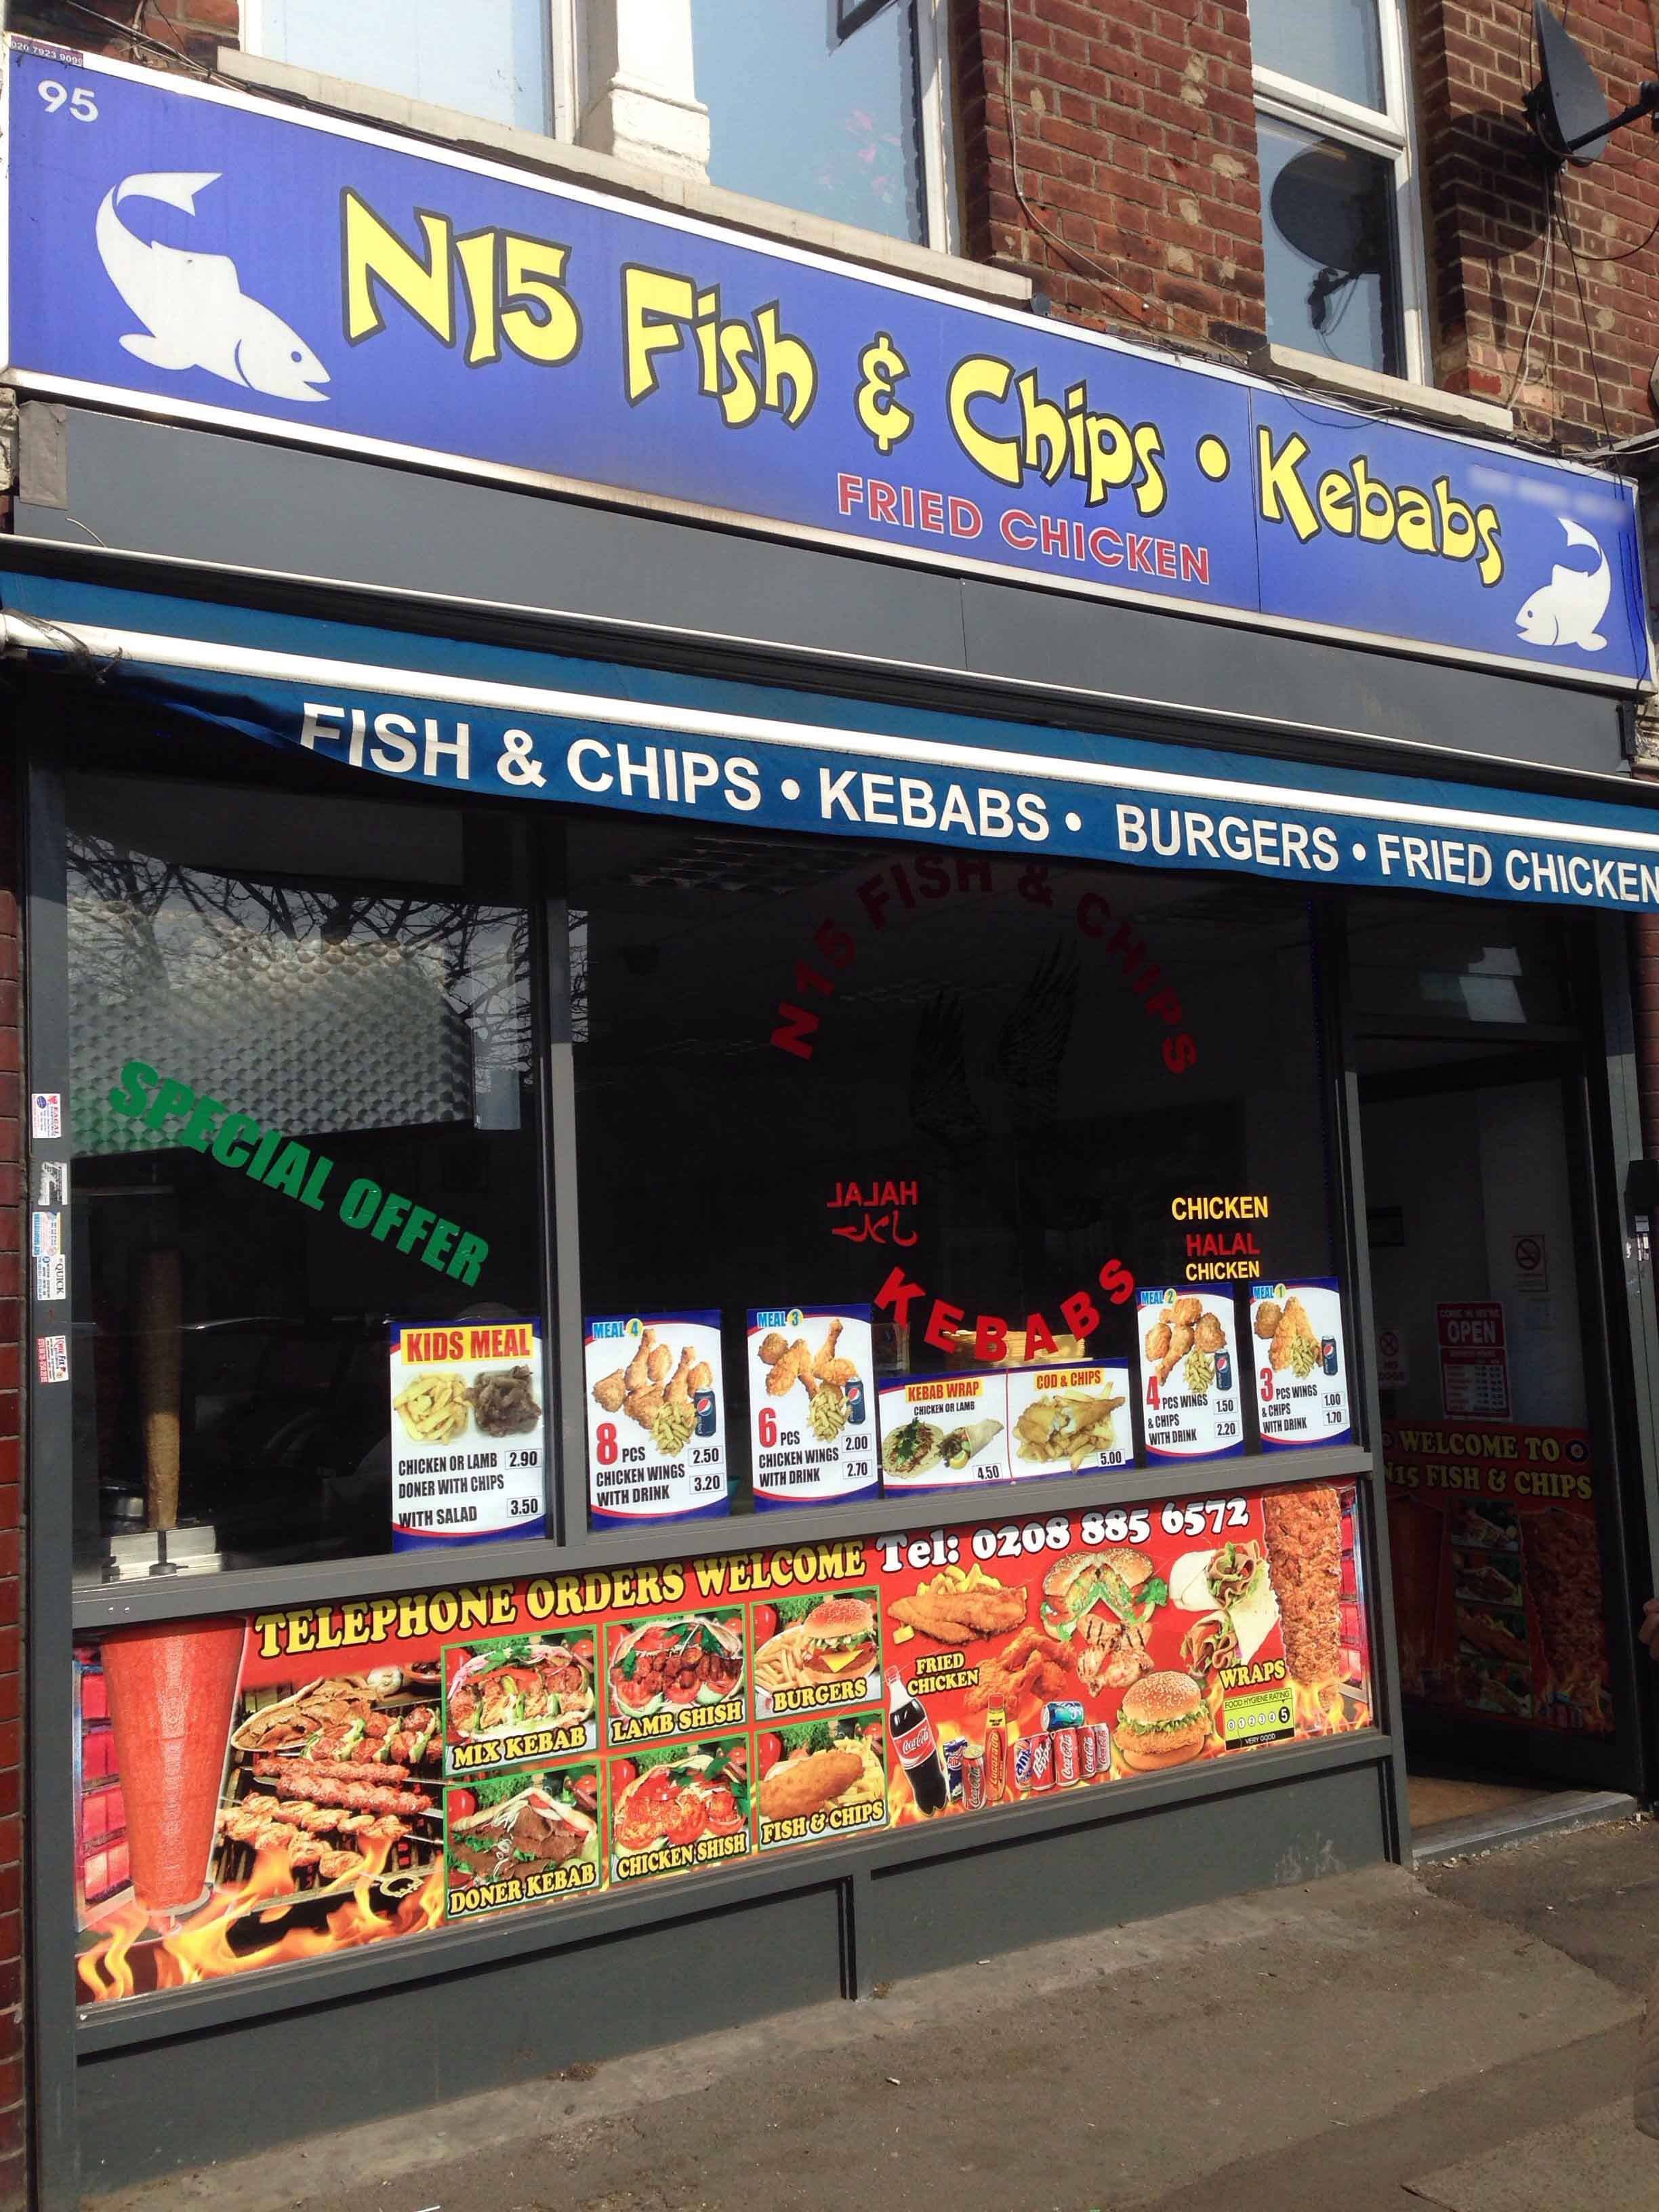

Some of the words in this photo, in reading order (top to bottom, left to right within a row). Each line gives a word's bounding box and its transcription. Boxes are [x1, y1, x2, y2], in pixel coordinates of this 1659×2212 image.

[33, 46, 56, 59] 7923
[38, 79, 98, 122] 95
[342, 188, 581, 367] N15
[621, 263, 817, 429] Fish
[855, 331, 914, 455] &
[948, 354, 1166, 517] Chips
[1257, 426, 1504, 586] Kebabs
[837, 472, 982, 539] FRIED
[1000, 510, 1210, 585] CHICKEN
[301, 702, 469, 779] FISH
[497, 729, 546, 788] &
[567, 739, 761, 811] CHIPS
[819, 768, 1049, 841] KEBABS
[1115, 804, 1338, 872] BURGERS
[1377, 834, 1492, 886] FRIED
[1506, 849, 1659, 903] CHICKEN
[769, 918, 856, 1063] N15
[857, 855, 993, 930] FISH
[1017, 864, 1052, 907] &
[1078, 893, 1197, 1073] CHIPS
[108, 1062, 335, 1211] SPECIAL
[339, 1178, 489, 1287] OFFER
[1172, 1197, 1268, 1220] CHICKEN
[1187, 1233, 1261, 1256] HALAL
[55, 1263, 64, 1294] QUICK
[1186, 1261, 1260, 1280] CHICKEN
[1141, 1291, 1164, 1305] MEAL
[1167, 1290, 1174, 1304] 2
[1252, 1286, 1274, 1300] MEAL
[1278, 1285, 1284, 1298] 1
[756, 1311, 786, 1328] MEAL
[792, 1311, 799, 1326] 3
[874, 1258, 1135, 1361] KEBABS
[592, 1322, 625, 1338] MEAL
[630, 1322, 638, 1336] 4
[1447, 1321, 1496, 1345] OPEN
[407, 1330, 464, 1361] KIDS
[470, 1328, 530, 1357] MEAL
[1036, 1374, 1057, 1389] COD
[1061, 1374, 1067, 1387] &
[1071, 1370, 1101, 1386] CHIPS
[1260, 1368, 1273, 1401] 3
[1276, 1387, 1291, 1400] PCS
[1292, 1385, 1317, 1398] WINGS
[908, 1384, 944, 1401] KEBAB
[946, 1381, 979, 1397] WRAP
[1147, 1376, 1160, 1410] 4
[1163, 1396, 1179, 1410] PCS
[1180, 1394, 1208, 1408] WINGS
[1324, 1394, 1341, 1406] 1.00
[914, 1404, 944, 1416] CHICKEN
[945, 1404, 955, 1413] OR
[956, 1401, 975, 1412] LAMB
[1216, 1399, 1233, 1412] 1.50
[1262, 1407, 1267, 1418] &
[1268, 1403, 1291, 1416] CHIPS
[758, 1408, 777, 1448] 6
[780, 1431, 800, 1446] PCS
[1147, 1418, 1153, 1429] &
[1155, 1414, 1180, 1428] CHIPS
[1263, 1419, 1283, 1433] WITH
[1284, 1417, 1307, 1431] DRINK
[1326, 1411, 1342, 1424] 1.70
[1149, 1431, 1171, 1446] WITH
[1172, 1429, 1197, 1443] DRINK
[1217, 1423, 1235, 1436] 2.20
[596, 1423, 618, 1465] 8
[622, 1447, 646, 1462] PCS
[845, 1436, 868, 1450] 2.00
[1398, 1431, 1519, 1459] WELCOME
[1525, 1437, 1561, 1462] TO
[398, 1457, 446, 1476] CHICKEN
[450, 1456, 464, 1471] OR
[468, 1453, 497, 1469] LAMB
[510, 1451, 537, 1467] 2.90
[693, 1448, 719, 1464] 2.50
[759, 1451, 803, 1469] CHICKEN
[805, 1448, 839, 1464] WINGS
[1100, 1451, 1122, 1465] 5.00
[596, 1468, 644, 1487] CHICKEN
[647, 1464, 685, 1481] WINGS
[759, 1471, 786, 1488] WITH
[789, 1468, 820, 1484] DRINK
[847, 1462, 867, 1477] 2.70
[977, 1465, 1000, 1480] 4.50
[398, 1480, 435, 1499] DONER
[438, 1477, 468, 1495] WITH
[471, 1474, 504, 1492] CHIPS
[694, 1475, 720, 1492] 3.20
[1426, 1464, 1481, 1491] FISH
[1487, 1467, 1507, 1492] &
[1514, 1470, 1593, 1500] CHIPS
[511, 1498, 538, 1515] 3.50
[597, 1489, 629, 1507] WITH
[632, 1485, 670, 1502] DRINK
[398, 1510, 433, 1528] WITH
[436, 1506, 477, 1524] SALAD
[255, 1583, 516, 1658] TELEPHONE
[526, 1562, 684, 1619] ORDERS
[693, 1540, 866, 1597] WELCOME
[876, 1530, 960, 1572] Tel:
[972, 1517, 1070, 1559] 0208
[1082, 1509, 1150, 1544] 885
[1161, 1497, 1249, 1536] 6572
[916, 1651, 965, 1676] FRIED
[1219, 1659, 1286, 1689] WRAPS
[907, 1668, 979, 1696] CHICKEN
[773, 1678, 867, 1712] BURGERS
[1225, 1700, 1243, 1709] FOOD
[1244, 1696, 1269, 1705] HYGIENE
[1269, 1690, 1290, 1701] RATING
[611, 1715, 674, 1743] LAMB
[678, 1701, 743, 1730] SHISH
[1281, 1708, 1288, 1721] 5
[453, 1740, 501, 1769] MIX
[505, 1726, 586, 1760] KEBAB
[1244, 1736, 1259, 1744] VERY
[1260, 1733, 1275, 1741] GOOD
[762, 1816, 806, 1844] FISH
[809, 1812, 827, 1833] &
[829, 1800, 884, 1829] CHIPS
[617, 1843, 695, 1879] CHICKEN
[696, 1832, 746, 1862] SHISH
[449, 1880, 523, 1914] DONER
[525, 1862, 596, 1897] KEBAB
